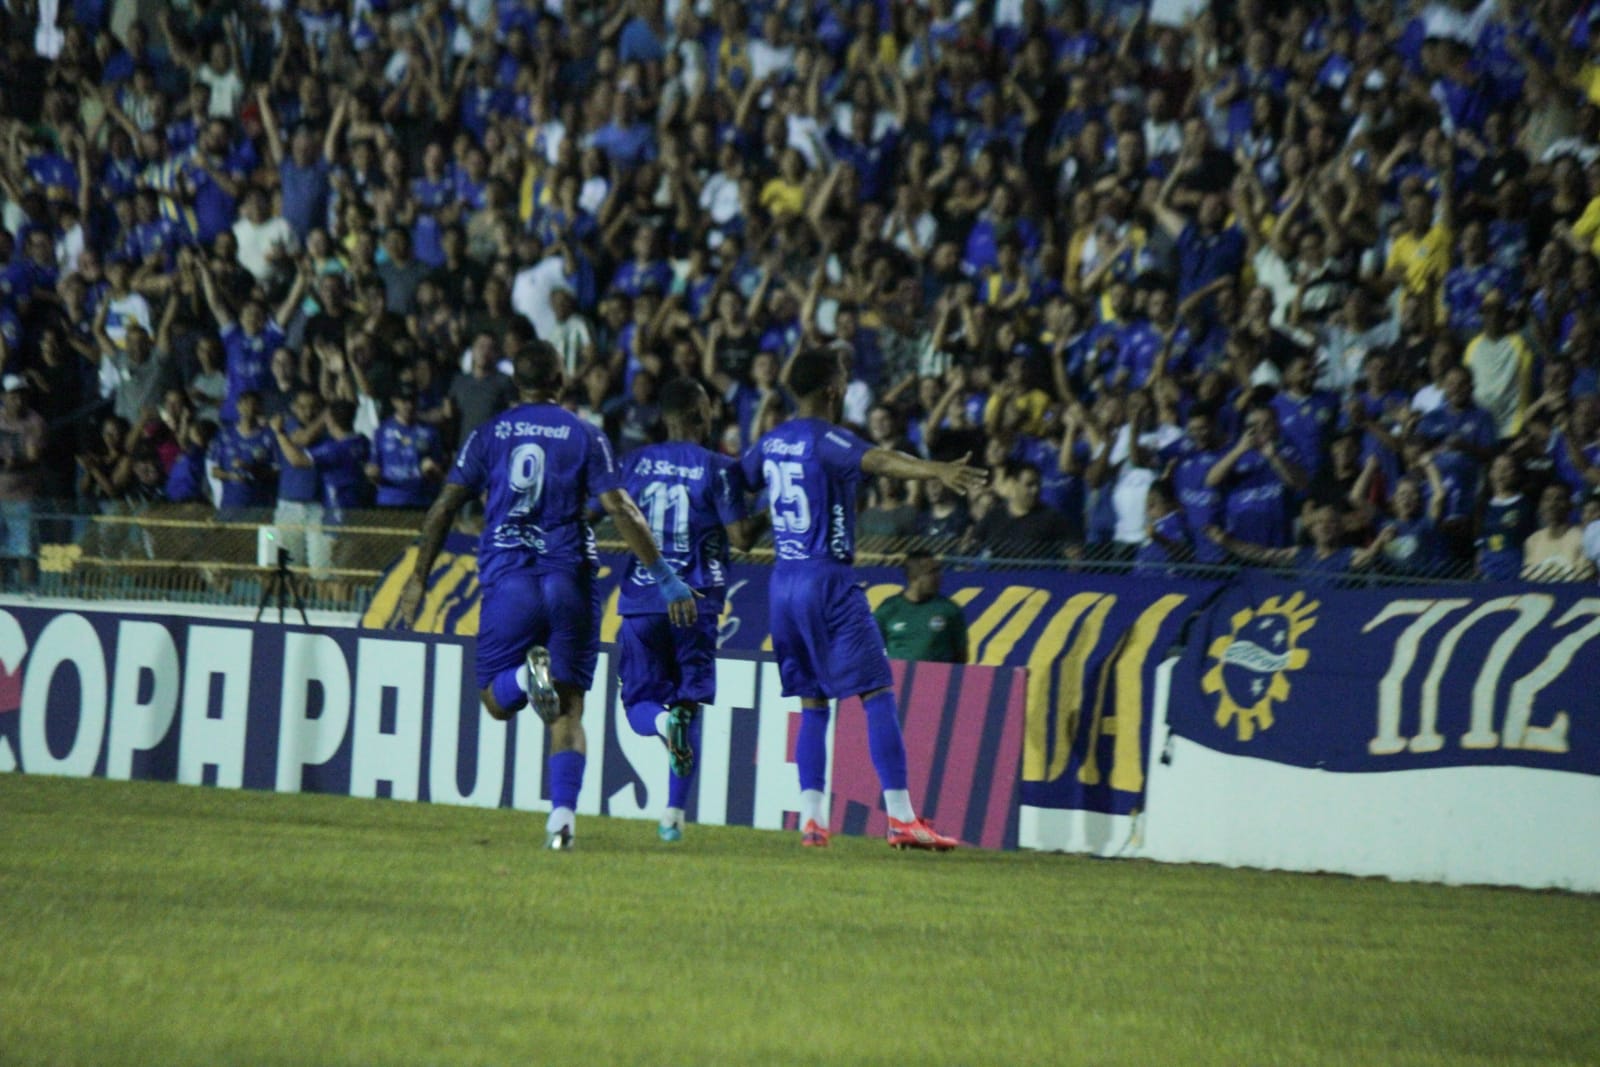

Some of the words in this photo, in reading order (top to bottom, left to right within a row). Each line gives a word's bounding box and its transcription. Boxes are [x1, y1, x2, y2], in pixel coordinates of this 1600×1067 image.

[513, 421, 571, 440] Sicredi
[507, 442, 547, 517] 9
[763, 459, 811, 534] 25
[640, 481, 690, 553] 11
